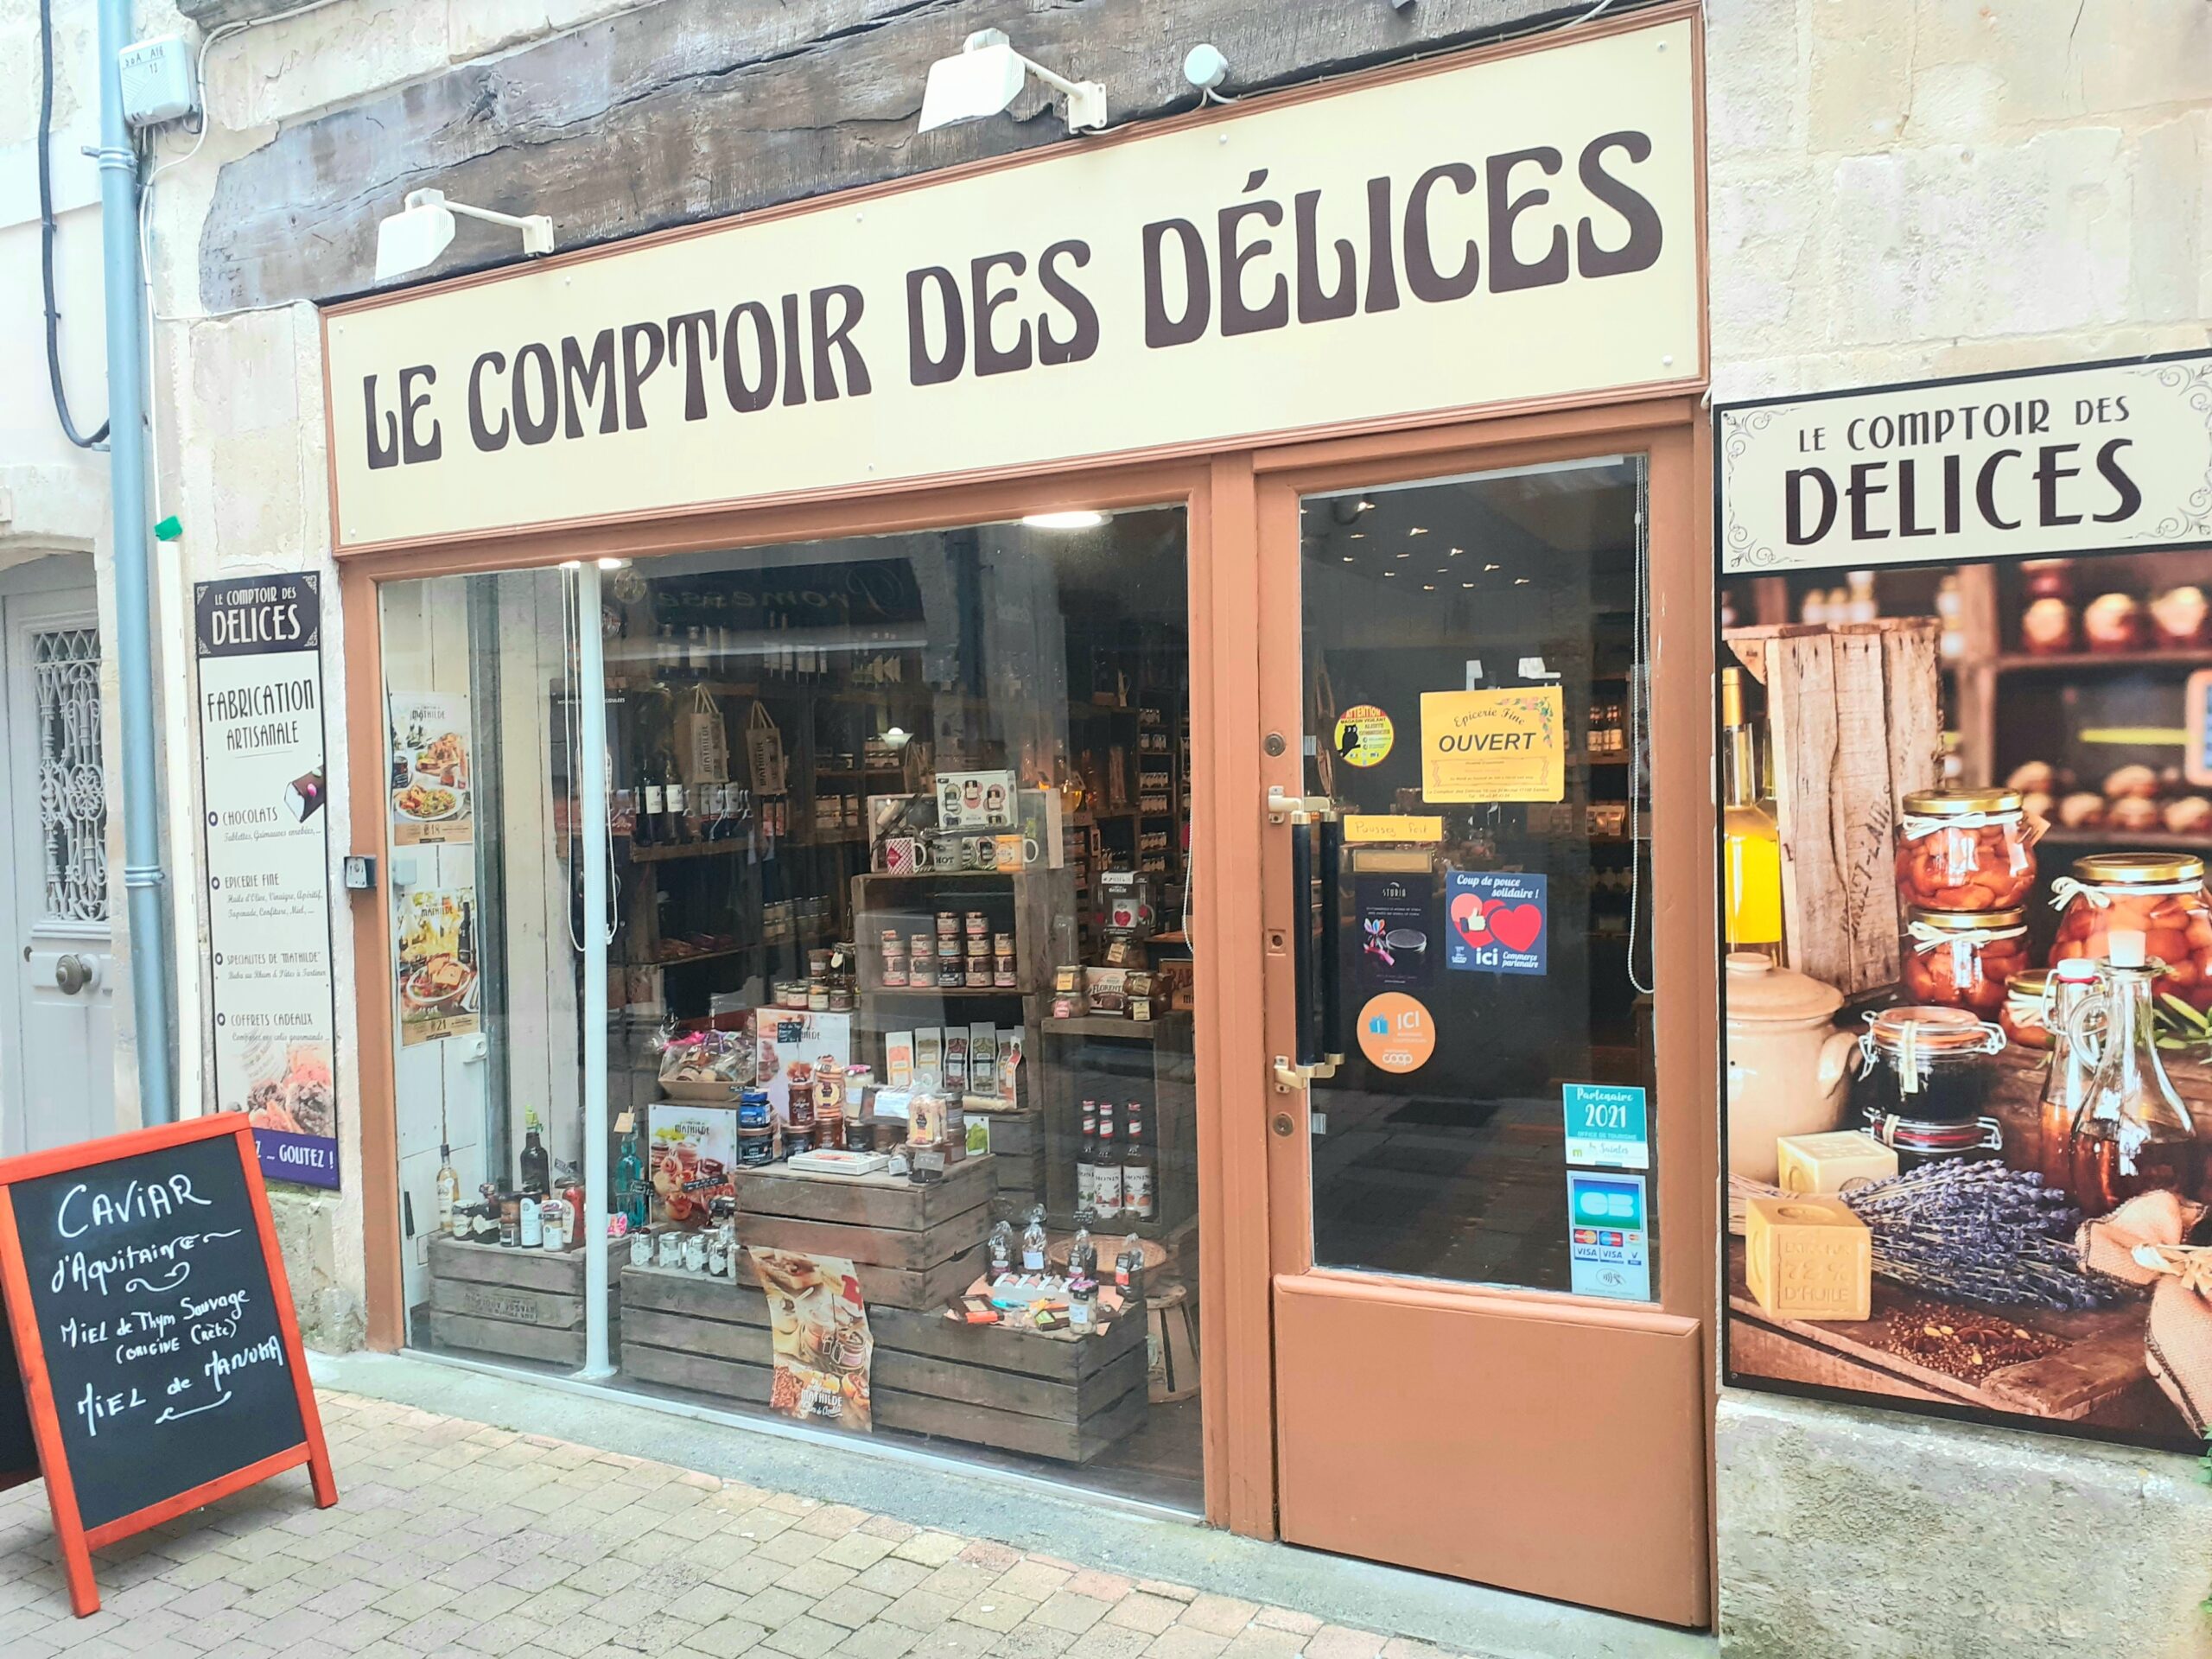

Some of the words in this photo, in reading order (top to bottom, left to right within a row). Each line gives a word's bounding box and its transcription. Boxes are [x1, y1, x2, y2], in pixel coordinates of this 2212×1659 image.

[363, 365, 442, 469] LE
[468, 285, 871, 452] COMPTOIR
[906, 239, 1100, 386] DES
[1142, 130, 1663, 348] DÉLICES
[1799, 427, 1826, 453] LE
[1847, 399, 2050, 451] COMPTOIR
[2075, 396, 2130, 426] DES
[1785, 438, 2142, 546] DELICES
[215, 593, 223, 606] LE
[226, 586, 277, 607] COMPTOIR
[282, 586, 297, 600] DES
[211, 603, 301, 646] DELICES
[207, 678, 315, 722] FABRICATION
[1345, 705, 1381, 719] ATTENTION
[1453, 707, 1497, 728] Epicerie
[1501, 708, 1525, 726] Fine
[226, 721, 299, 751] ARTISANALE
[1439, 732, 1536, 753] OUVERT
[223, 806, 278, 826] CHOCOLATS
[225, 874, 258, 889] EPICERIE
[262, 874, 280, 886] FINE
[1456, 874, 1479, 887] Coup
[1481, 876, 1493, 887] de
[1493, 878, 1521, 888] pouce
[1491, 887, 1534, 899] solidaire
[226, 953, 266, 965] SPECIALITES
[269, 953, 277, 964] DE
[1476, 947, 1498, 966] ici
[1503, 951, 1538, 961] Commerce
[1502, 960, 1539, 969] partenaire
[230, 1014, 270, 1027] COFFRETS
[273, 1013, 314, 1026] CADEAUX
[1397, 1010, 1421, 1030] ICI
[1382, 1053, 1414, 1065] coop
[1576, 1087, 1634, 1102] Partenaire
[1585, 1103, 1626, 1128] 2021
[279, 1144, 325, 1168] GOUTEZ
[1599, 1143, 1630, 1155] Saintes
[1577, 1248, 1598, 1256] VISA
[1603, 1250, 1623, 1259] VISA
[116, 1318, 133, 1337] de
[130, 1312, 175, 1338] Thym
[180, 1289, 251, 1320] Sauvage
[167, 1377, 194, 1395] de
